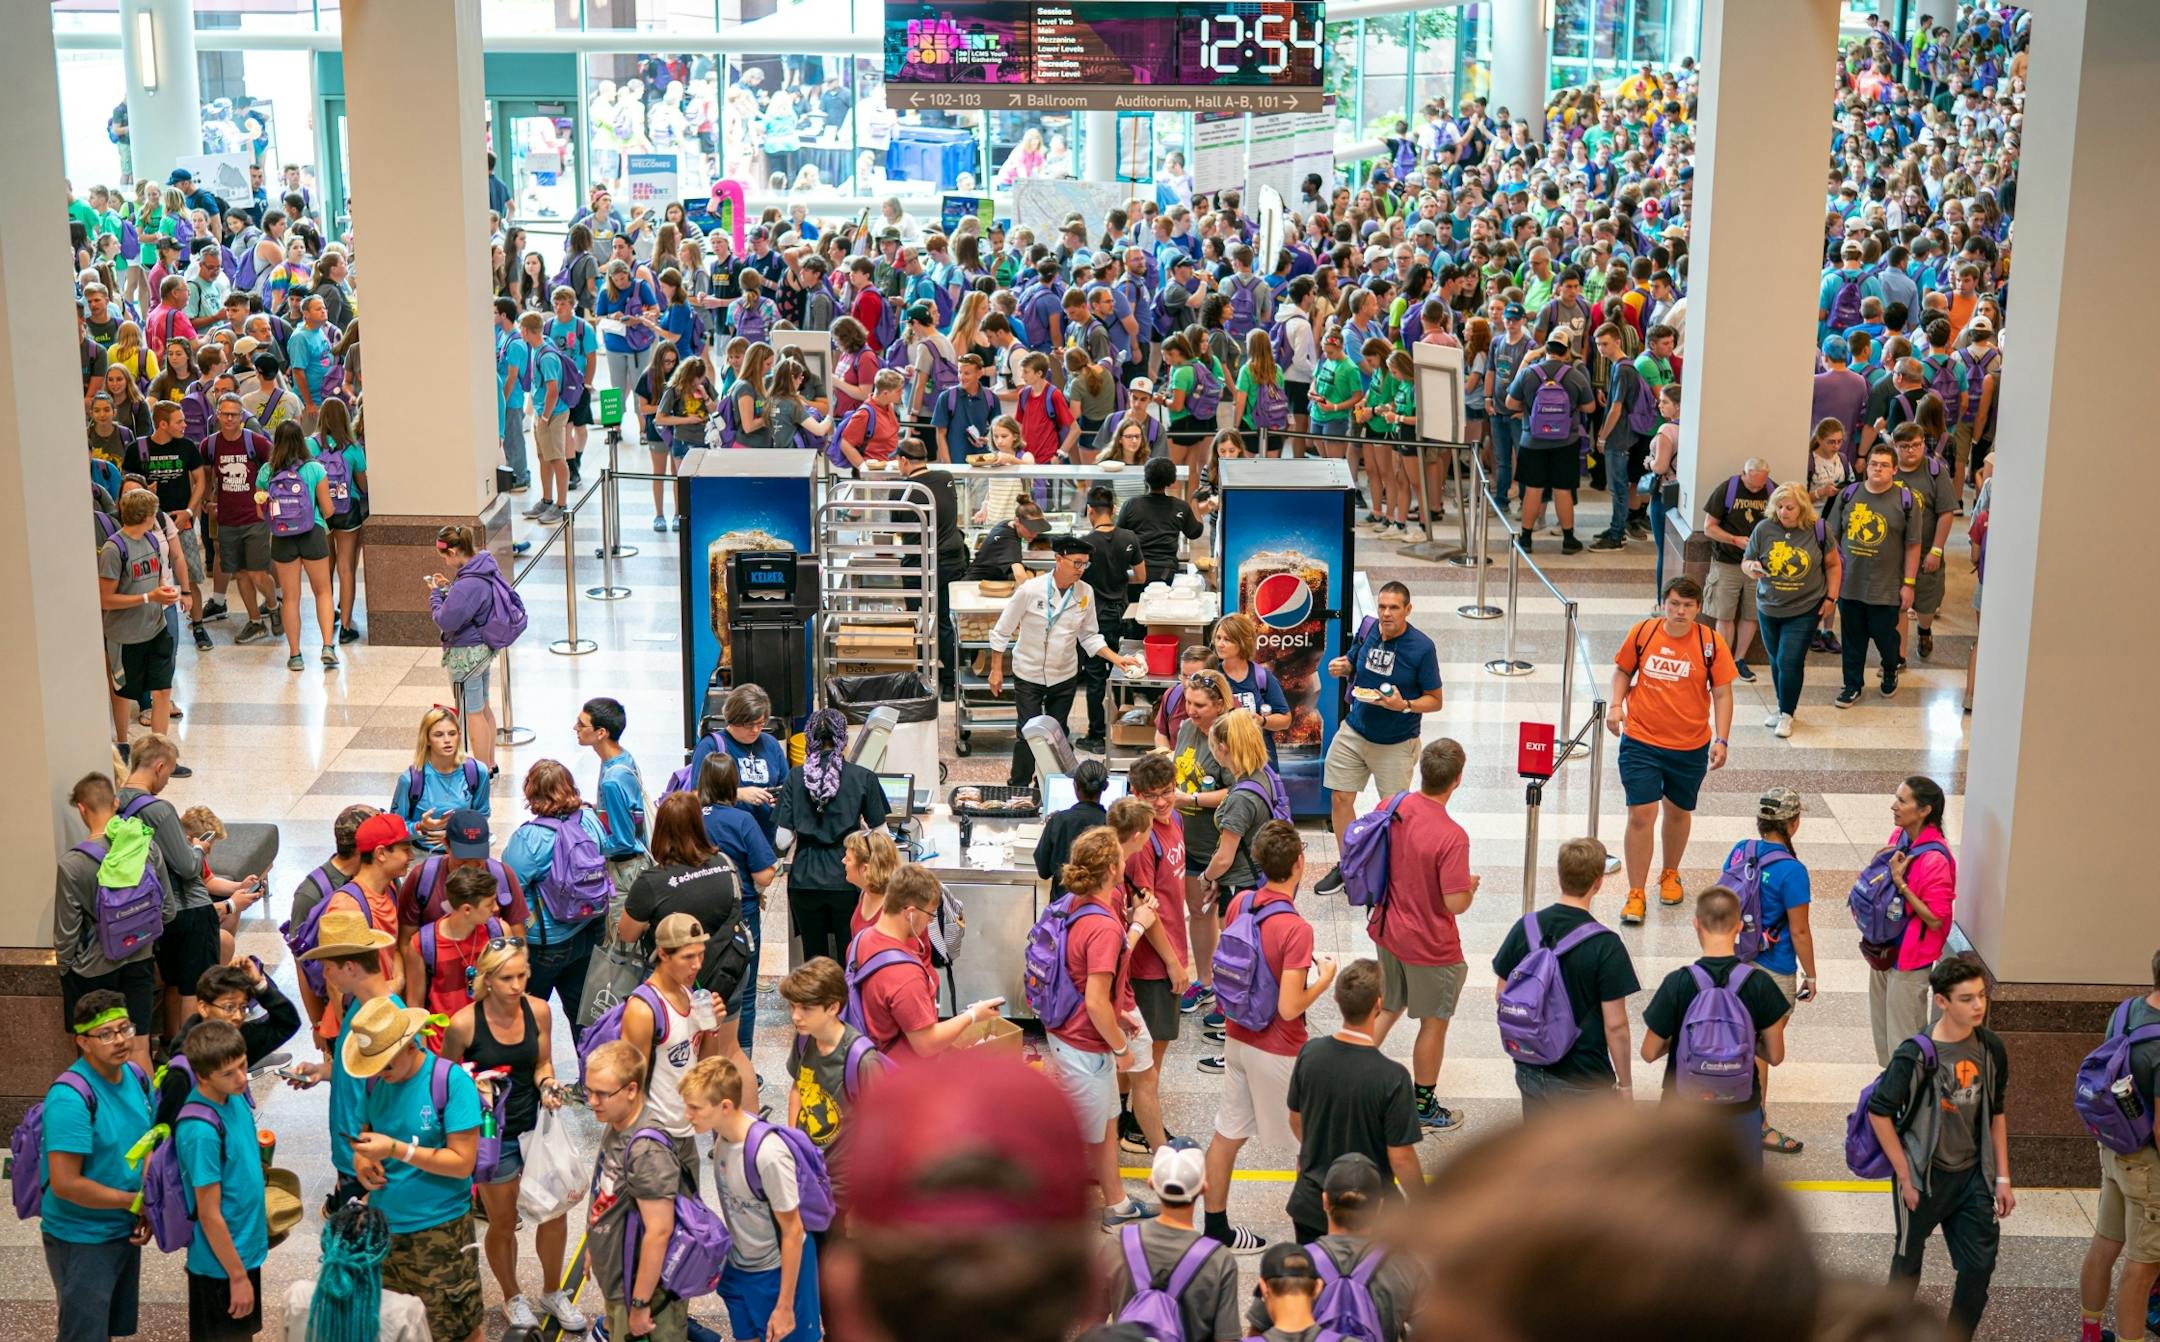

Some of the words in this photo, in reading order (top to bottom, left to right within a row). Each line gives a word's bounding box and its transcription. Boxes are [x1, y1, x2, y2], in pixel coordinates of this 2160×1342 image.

[1037, 7, 1072, 16] Sessions
[1037, 18, 1056, 26] Level
[1057, 18, 1074, 26] Two
[1037, 27, 1055, 35] Main
[907, 34, 1001, 50] PRESENT.
[1037, 36, 1076, 44] Mezzanine
[1201, 14, 1323, 73] 12:54
[1037, 45, 1059, 53] Lower
[1060, 45, 1084, 53] Levels
[1037, 60, 1079, 68] Recreation
[1037, 70, 1059, 78] Lower
[1060, 70, 1081, 78] Level
[929, 94, 981, 106] 102-103
[1027, 94, 1088, 106] Ballroom
[1115, 95, 1192, 109] Auditorium,
[1195, 95, 1221, 108] Hall
[1224, 95, 1253, 109] A-B,
[1257, 95, 1279, 108] 101
[220, 455, 235, 463] SAVE
[1256, 632, 1309, 651] pepsi
[1526, 742, 1547, 752] EXIT
